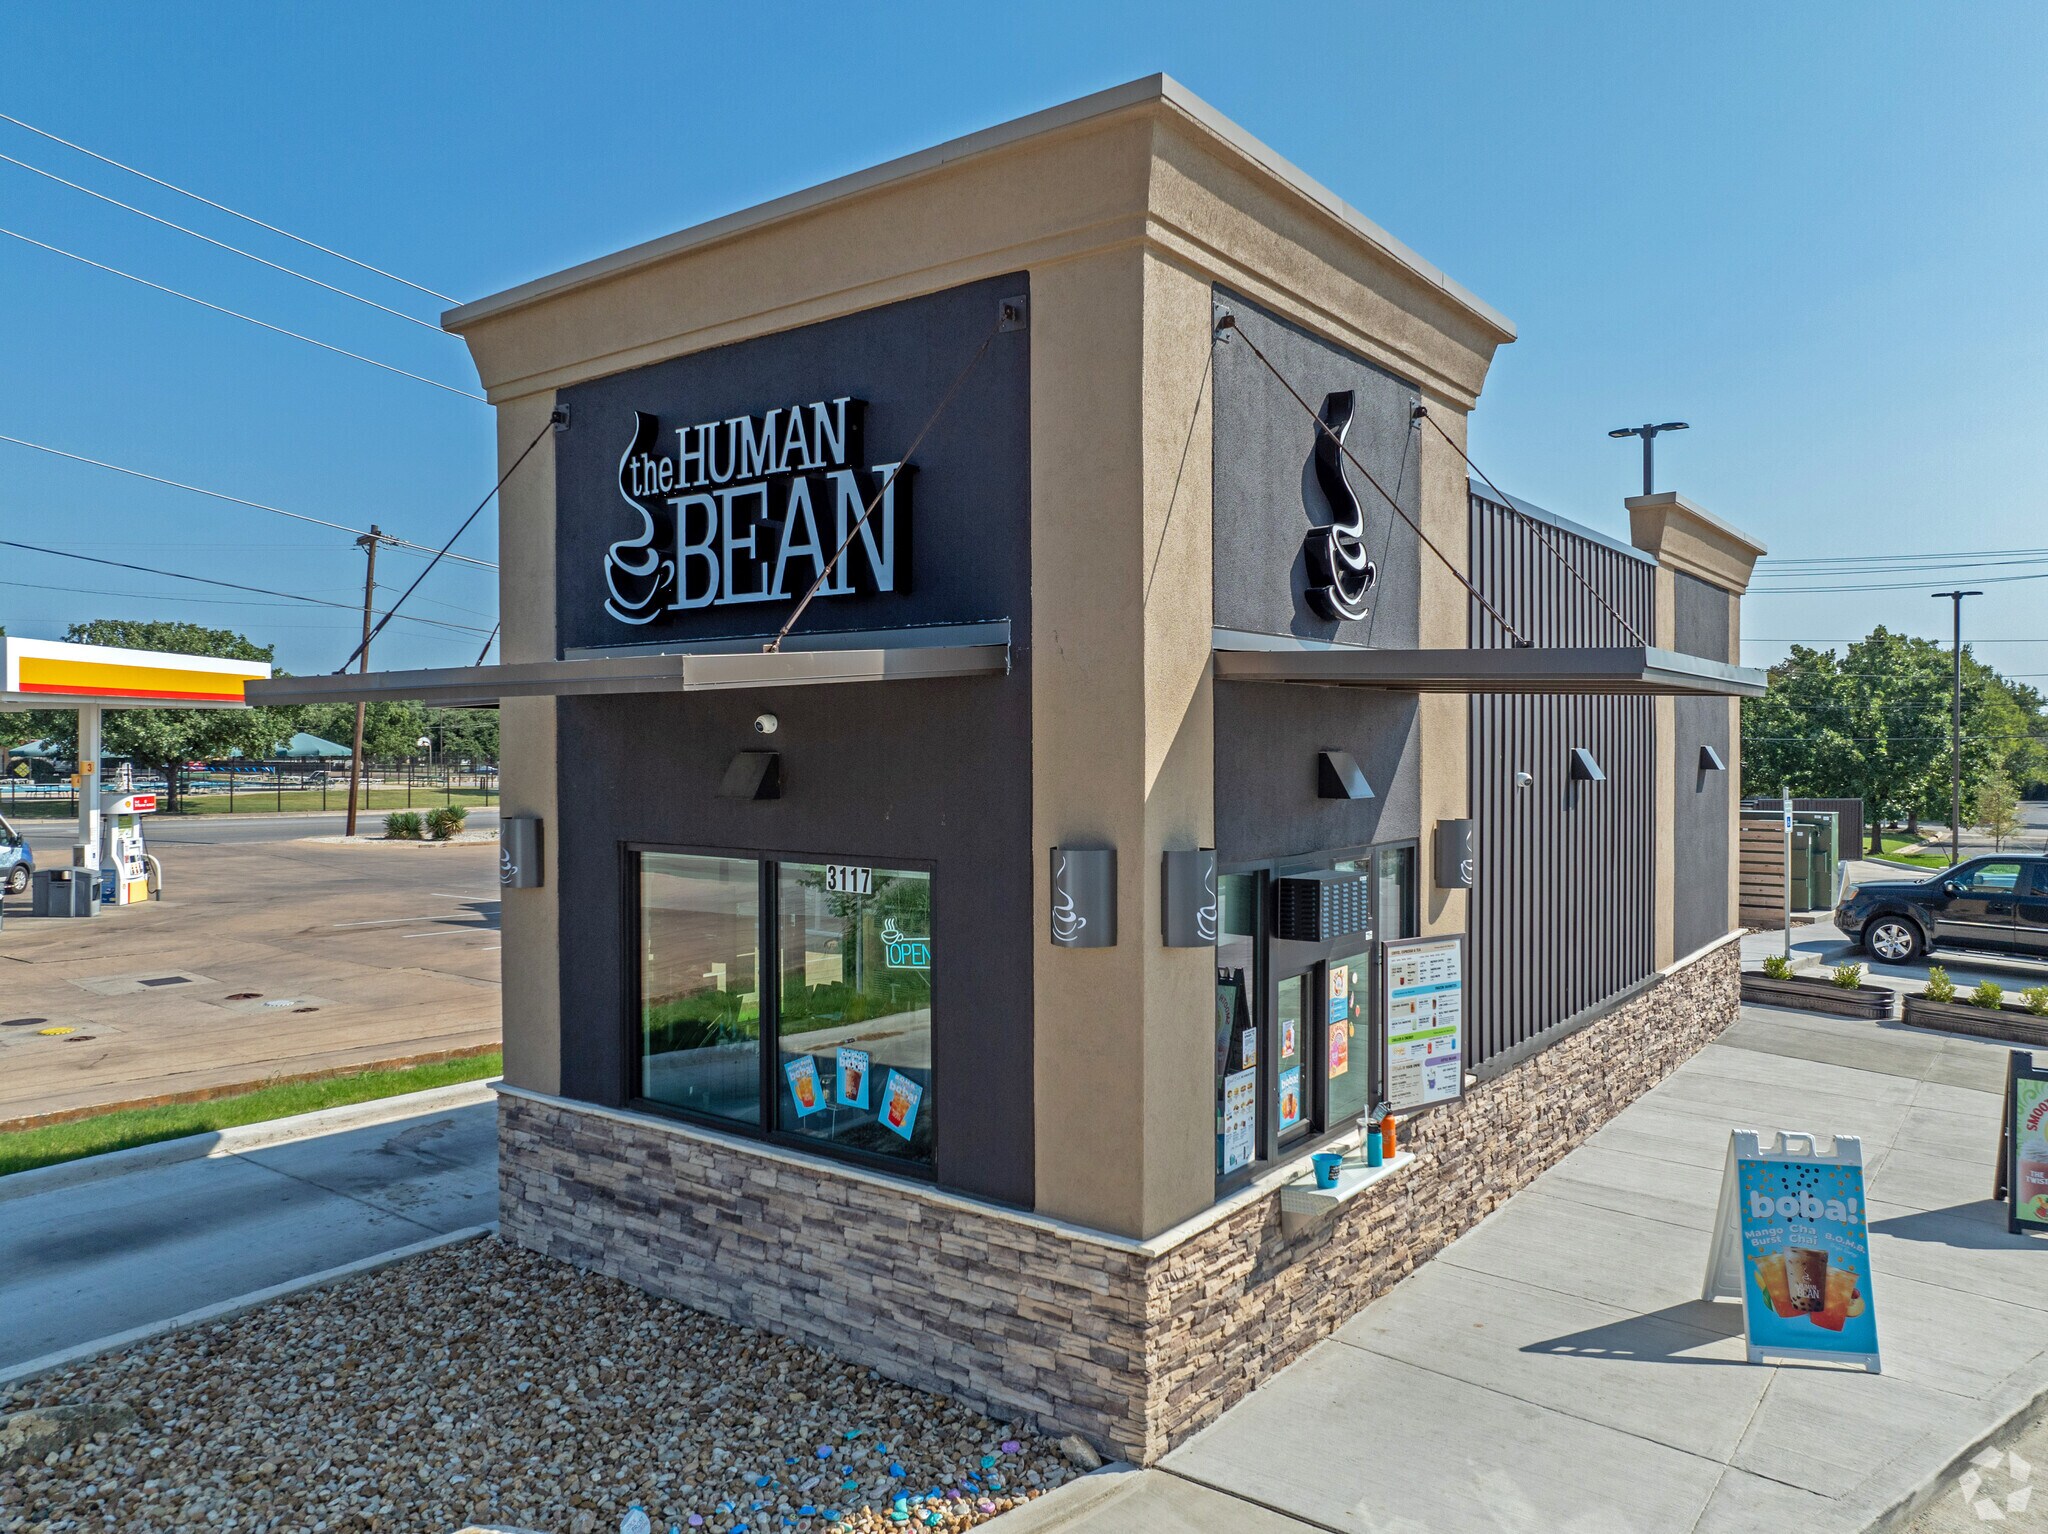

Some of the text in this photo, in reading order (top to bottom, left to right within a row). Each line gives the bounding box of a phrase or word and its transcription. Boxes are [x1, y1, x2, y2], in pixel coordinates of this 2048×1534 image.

[629, 397, 851, 497] the HUMAN
[667, 462, 901, 610] BEAN
[87, 763, 93, 772] 3
[827, 865, 870, 893] 3117
[1750, 1190, 1858, 1224] boba!
[1745, 1227, 1784, 1239] Mango
[1788, 1223, 1817, 1235] Cha
[1751, 1235, 1782, 1246] Burst
[1788, 1234, 1819, 1245] Chai
[1825, 1232, 1866, 1254] B.O.M.B.
